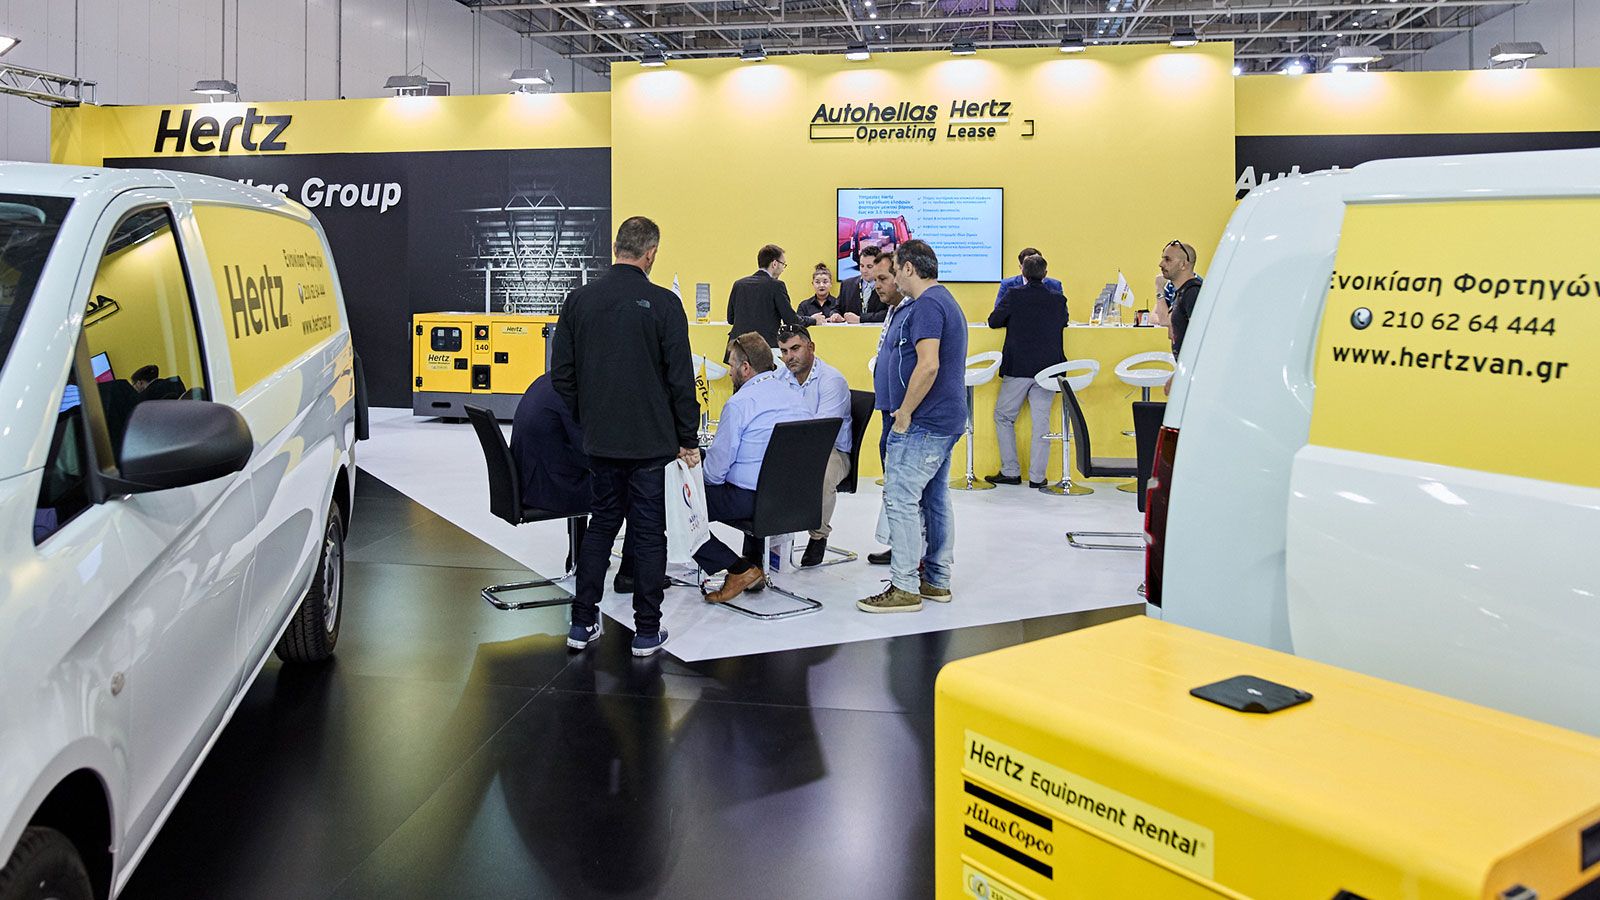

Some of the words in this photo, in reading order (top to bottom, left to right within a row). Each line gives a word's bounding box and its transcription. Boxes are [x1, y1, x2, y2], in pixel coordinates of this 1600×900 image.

[811, 102, 938, 123] Autohellas
[950, 99, 1011, 117] Hertz
[153, 107, 292, 153] Hertz
[856, 125, 937, 141] Operating
[947, 124, 996, 138] Lease
[301, 177, 401, 213] Group
[224, 264, 289, 339] Hertz
[1382, 310, 1424, 329] 210
[1431, 313, 1460, 331] 62
[1468, 314, 1499, 333] 64
[1507, 316, 1556, 336] 444
[428, 354, 450, 362] Hertz
[1332, 347, 1569, 383] www.hertzvan.gr
[970, 740, 1024, 781] Hertz
[1030, 772, 1127, 826] Equipment
[1132, 815, 1198, 857] Rental
